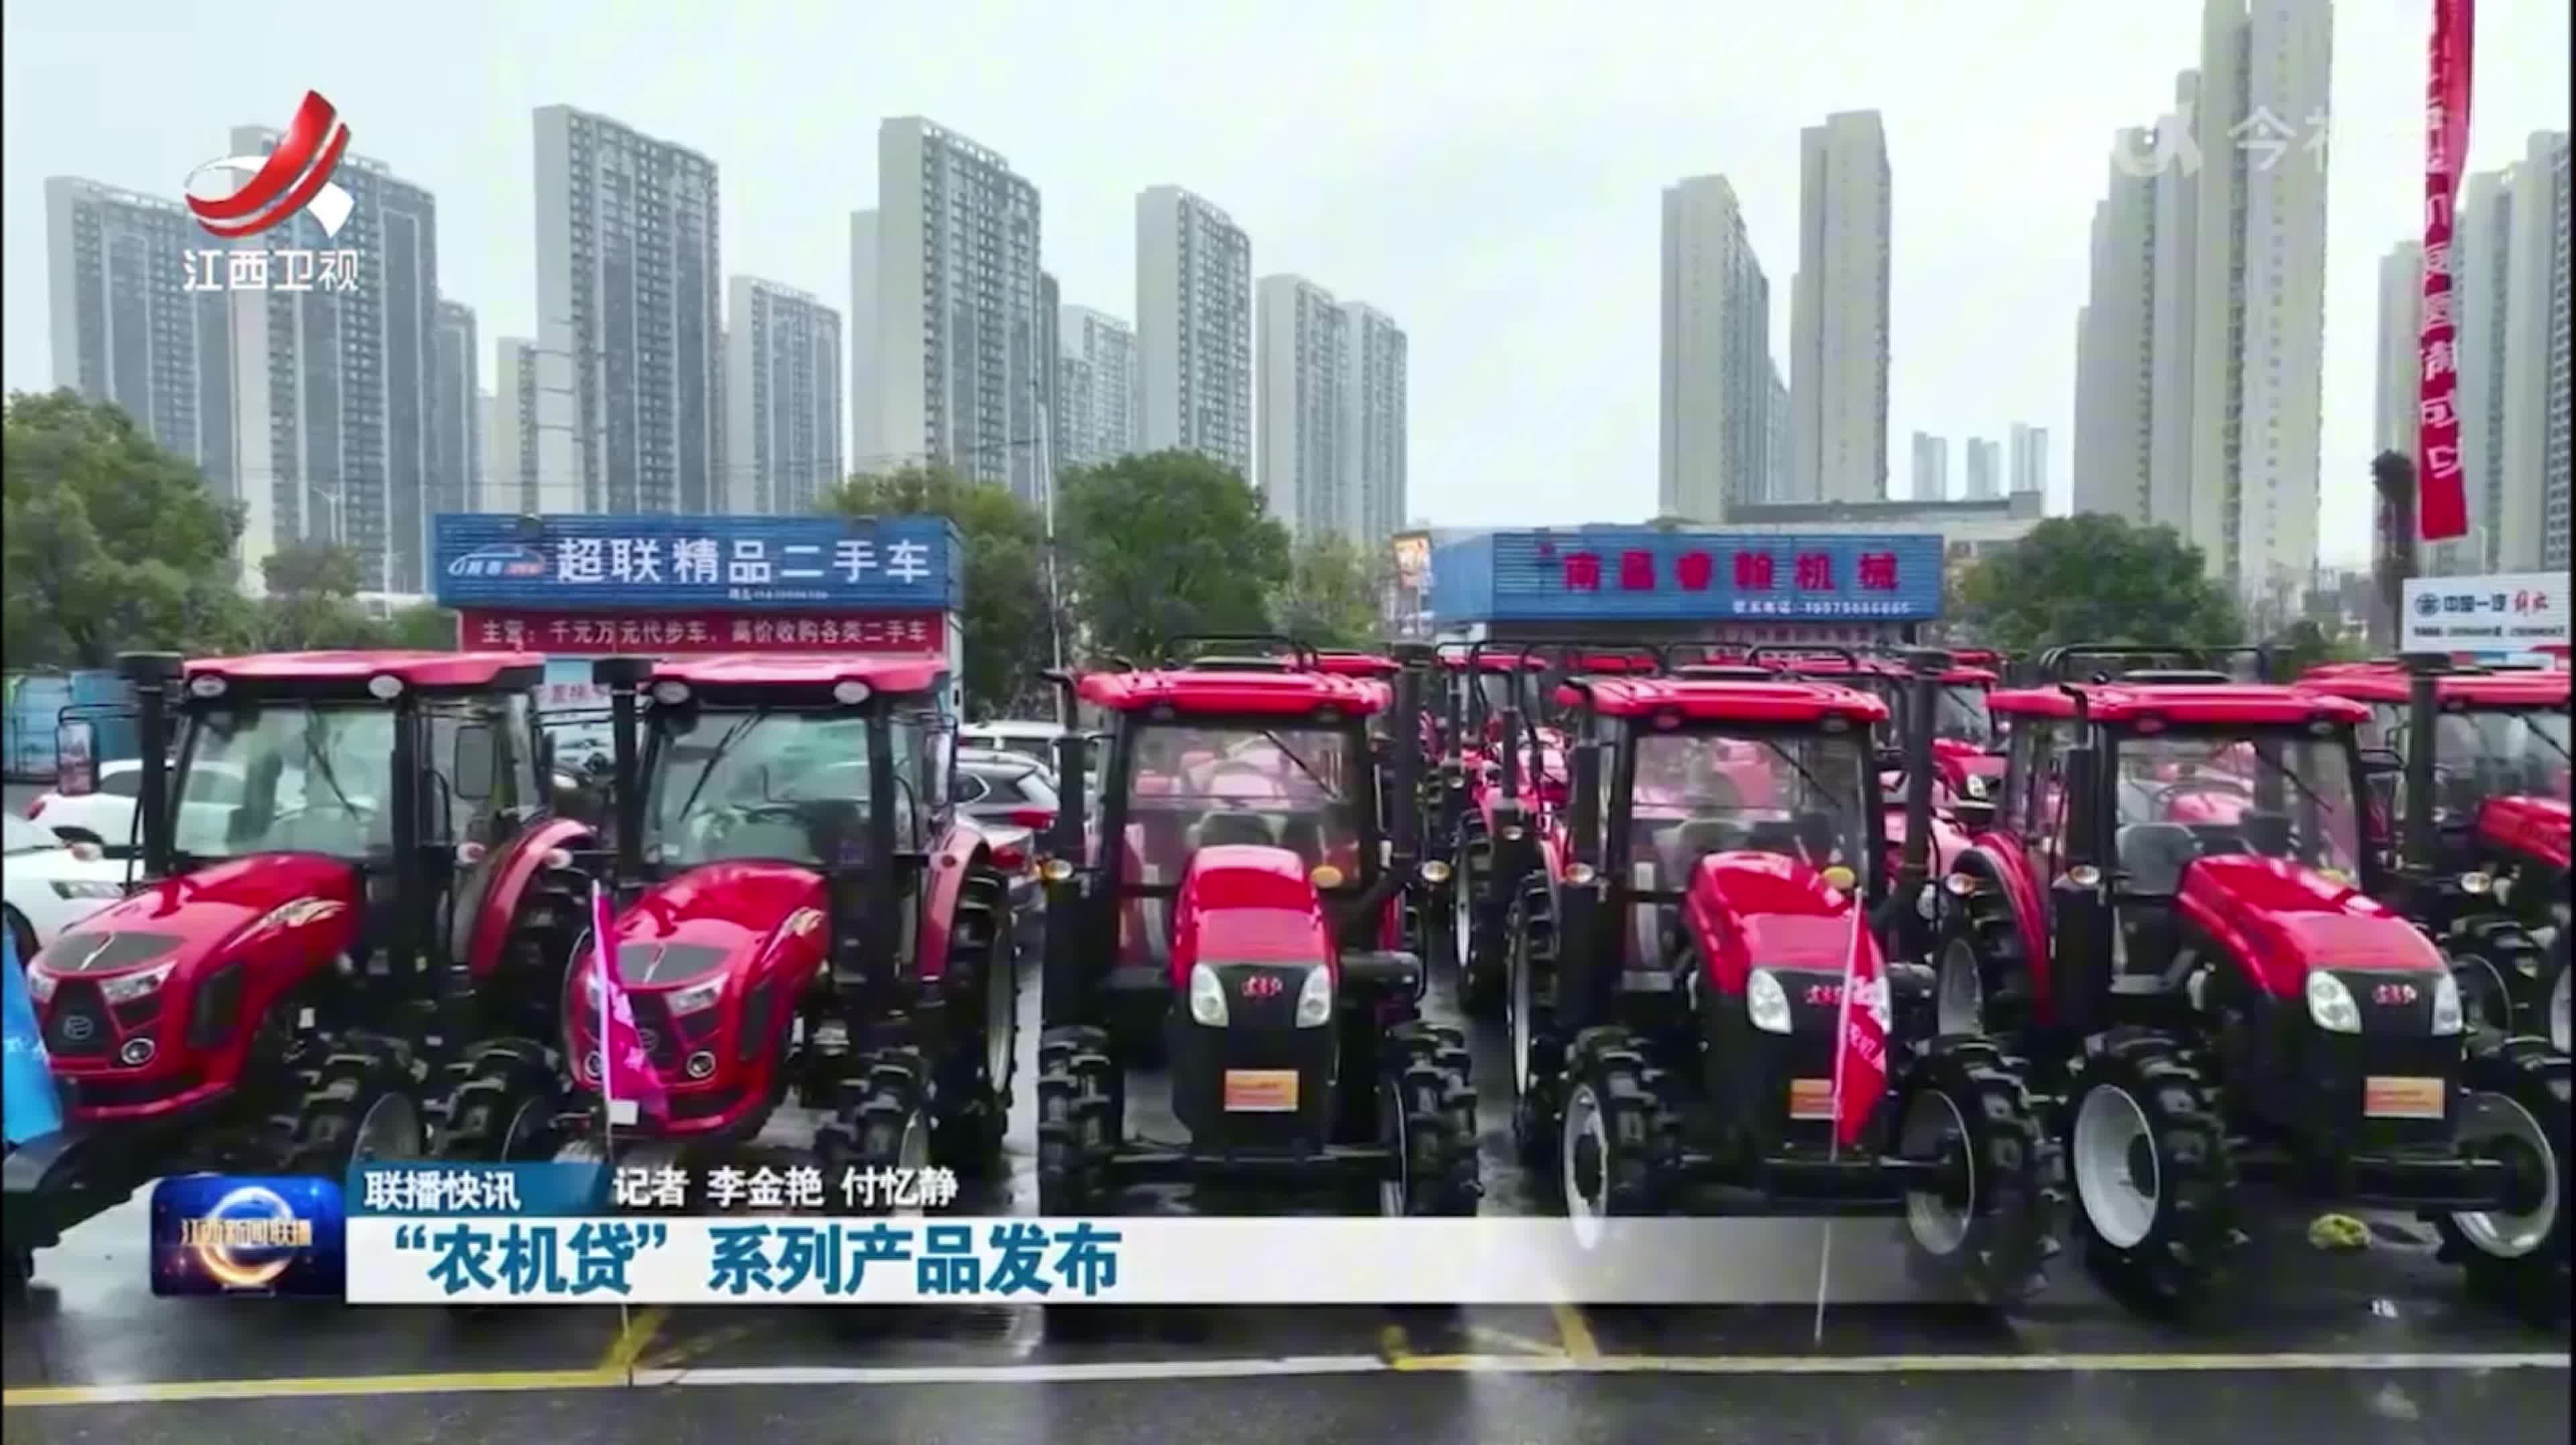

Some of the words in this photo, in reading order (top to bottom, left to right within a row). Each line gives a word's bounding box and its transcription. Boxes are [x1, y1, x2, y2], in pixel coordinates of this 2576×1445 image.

[556, 537, 932, 584] 超联精品二手车
